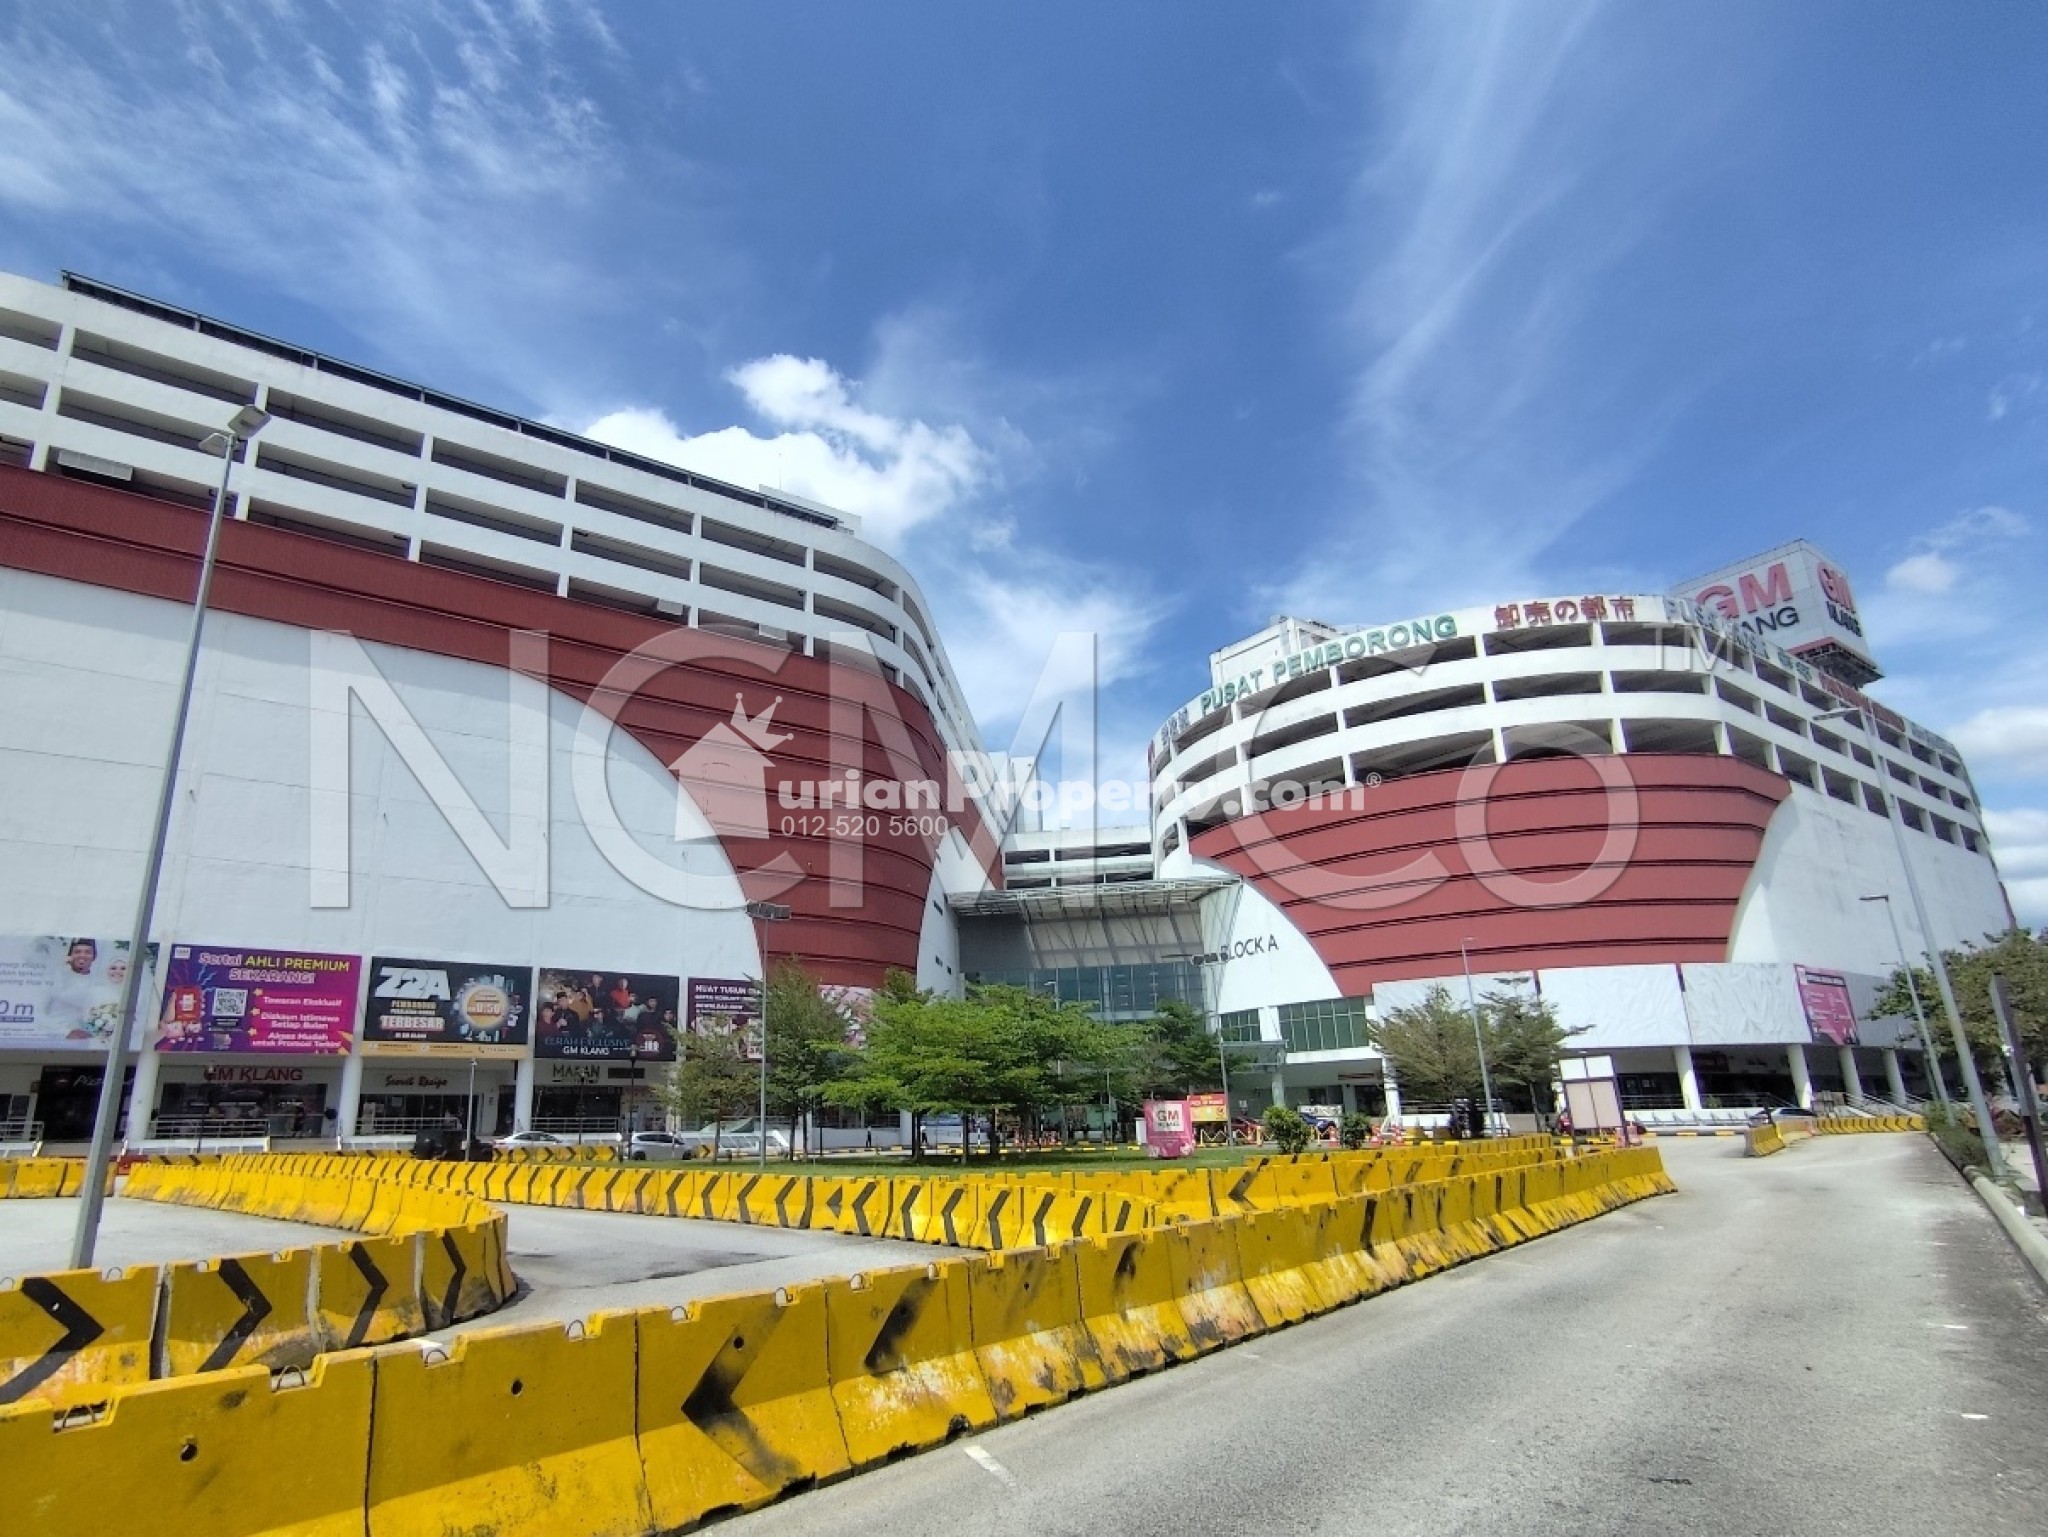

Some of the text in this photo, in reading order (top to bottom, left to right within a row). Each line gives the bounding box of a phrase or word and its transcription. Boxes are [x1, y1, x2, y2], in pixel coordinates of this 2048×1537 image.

[1696, 562, 1794, 619] GM
[1740, 606, 1799, 636] ANG
[1200, 614, 1458, 716] PUSAT PEMBORONG
[1268, 934, 1279, 952] A
[245, 955, 280, 967] AHLI
[284, 957, 349, 972] PREMIUM
[380, 1014, 446, 1031] TERBESAR
[580, 1046, 610, 1056] KLANG
[239, 1067, 303, 1081] KLANG
[552, 1063, 600, 1078] MAKAN
[1156, 1110, 1180, 1122] GM
